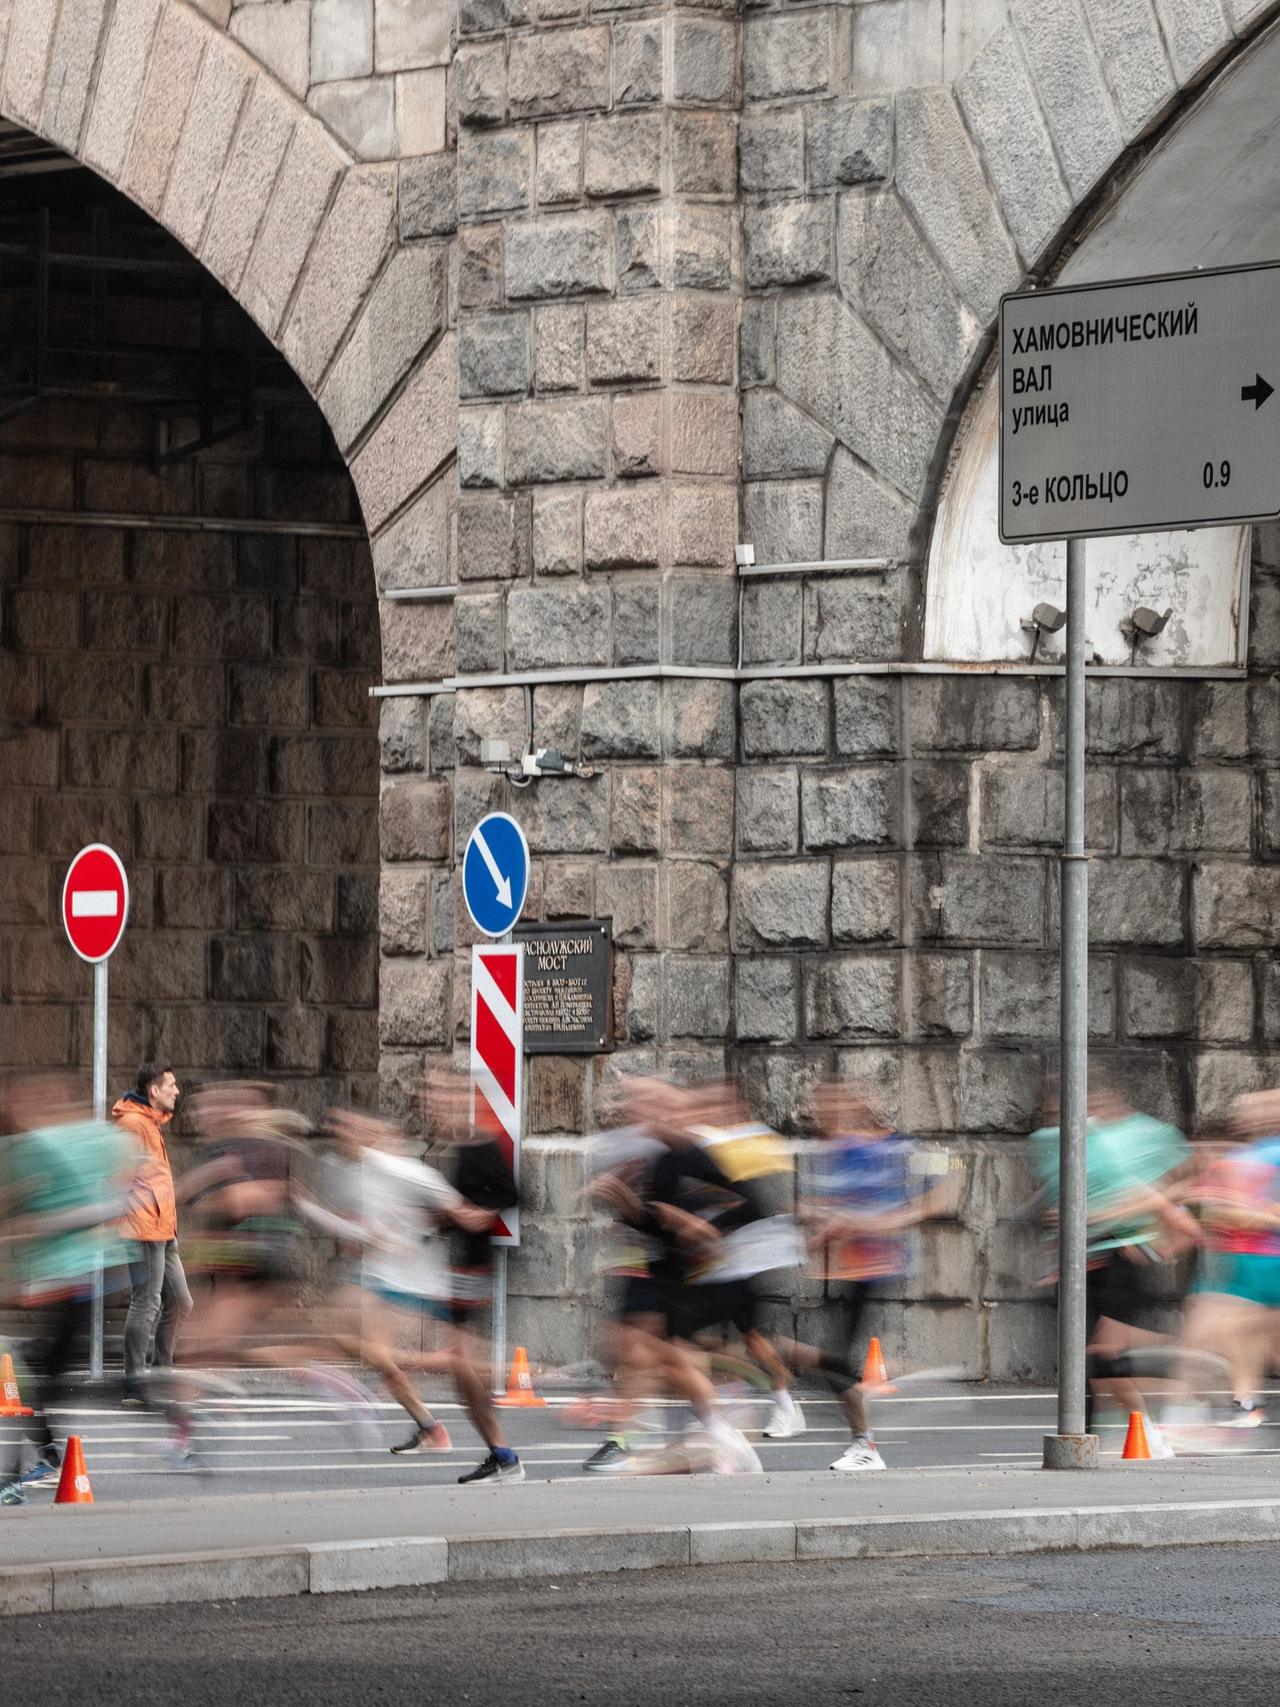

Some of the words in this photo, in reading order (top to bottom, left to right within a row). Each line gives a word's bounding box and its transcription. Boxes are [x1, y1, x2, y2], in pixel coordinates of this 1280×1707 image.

[1012, 302, 1198, 354] ХАМОВНИЧЕСКИЙ
[1013, 364, 1052, 394] ВАЛ
[1012, 401, 1069, 434] улица
[1012, 481, 1039, 506] 3-е
[1045, 470, 1129, 504] КОЛЬЦО
[1203, 460, 1231, 488] 0.9
[514, 936, 592, 956] АСНОЛУЖСКИЙ
[538, 955, 567, 970] МОСТ
